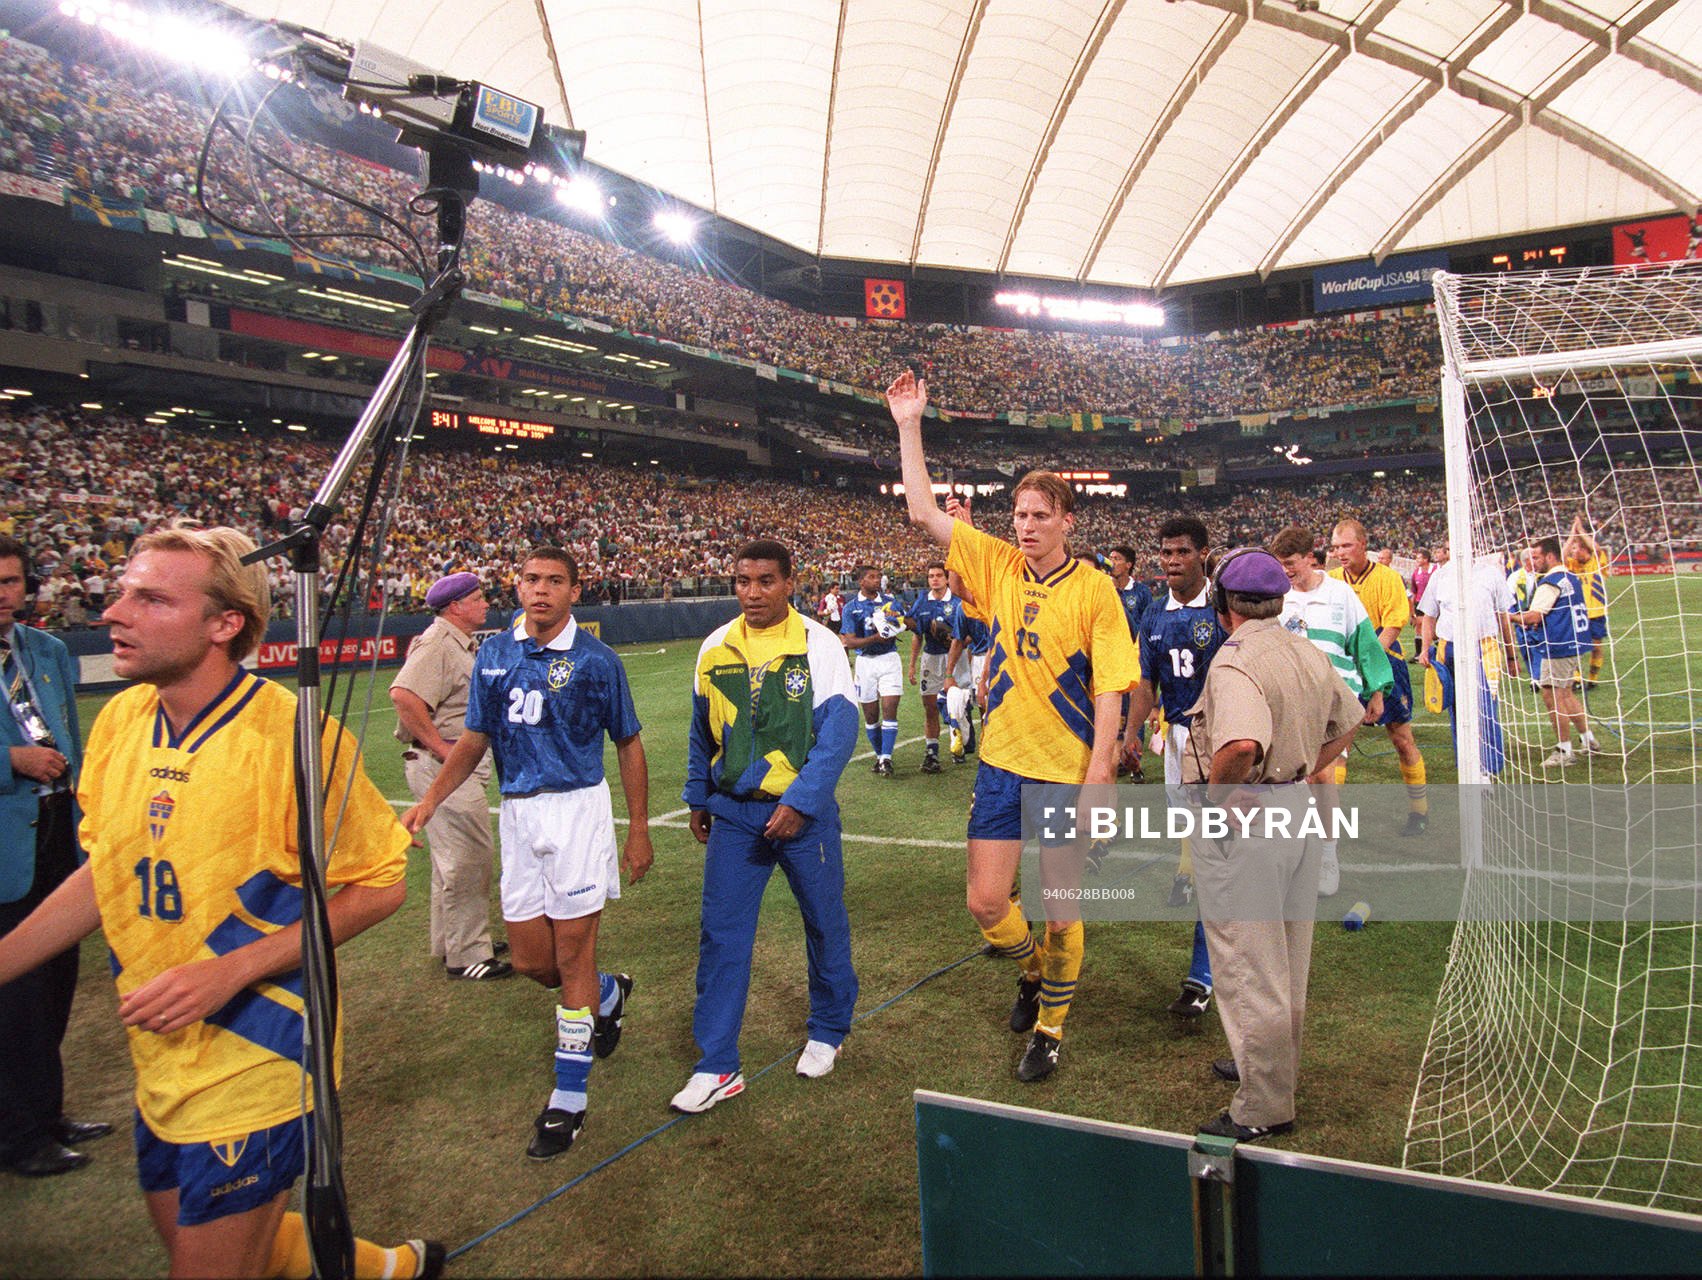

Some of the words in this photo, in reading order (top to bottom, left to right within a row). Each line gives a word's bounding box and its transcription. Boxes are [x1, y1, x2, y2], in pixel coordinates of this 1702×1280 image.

[485, 91, 525, 117] EBU
[474, 122, 490, 132] Host
[432, 411, 459, 429] 3:41
[468, 415, 496, 426] WELCOME
[1024, 589, 1048, 599] adidas
[260, 643, 299, 663] JVC
[332, 644, 359, 656] VDEO
[360, 638, 395, 657] JVC
[1016, 627, 1042, 660] 19
[715, 666, 745, 676] UMBRO
[1168, 648, 1195, 679] 13
[508, 687, 544, 726] 20
[150, 765, 190, 783] adidas
[134, 856, 185, 924] 18
[567, 883, 597, 897] UMBRO
[210, 1173, 260, 1198] adidas
